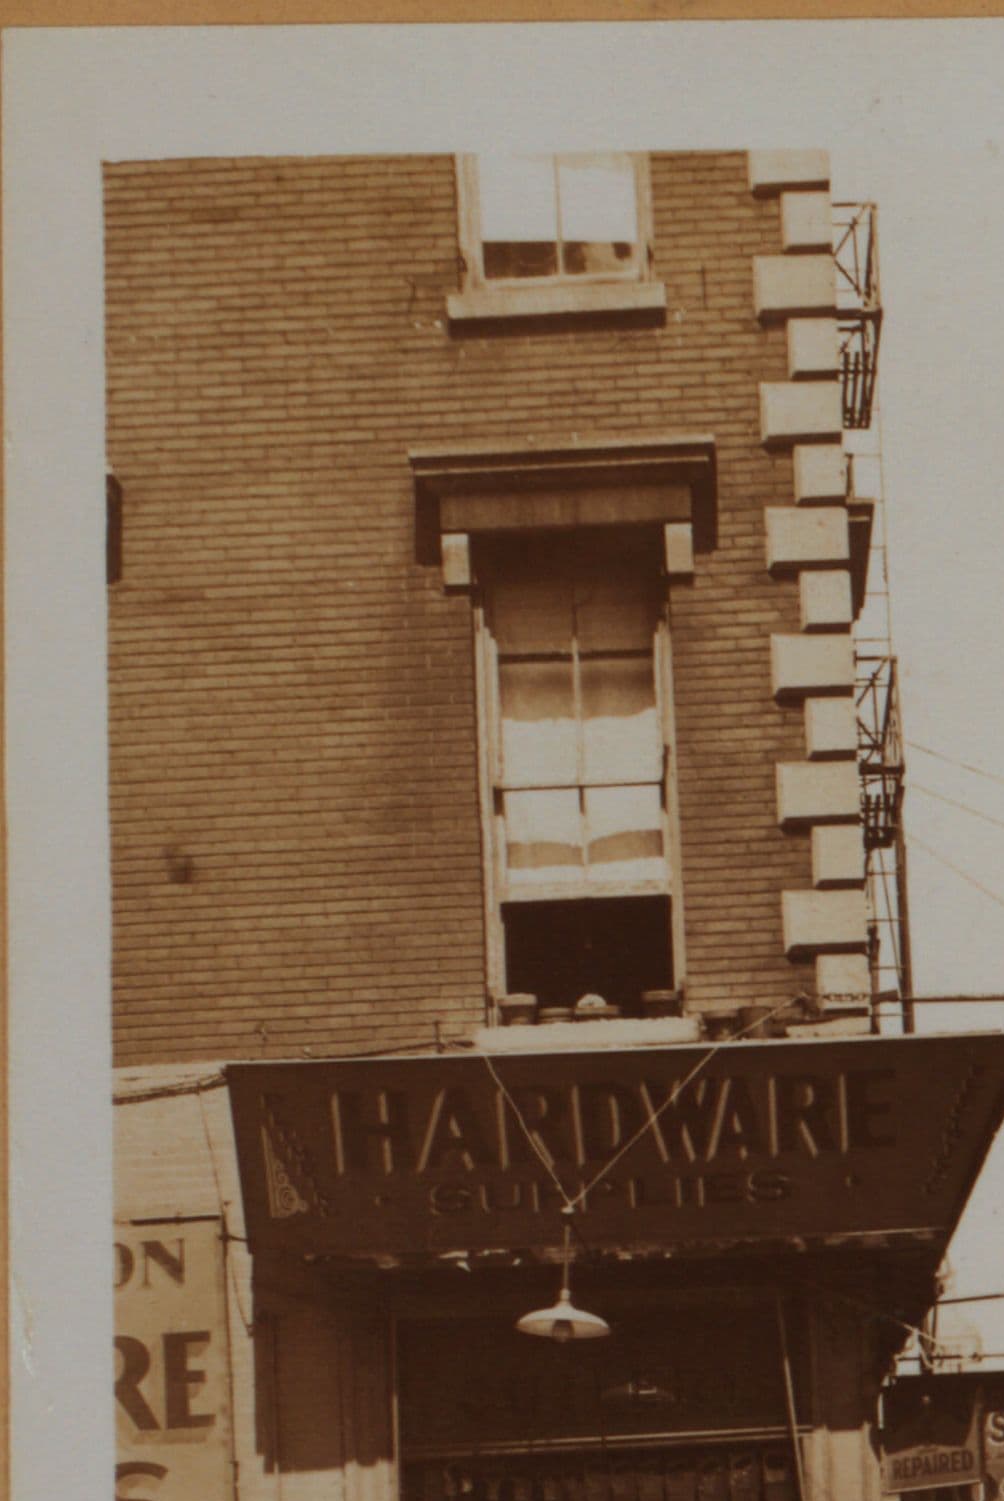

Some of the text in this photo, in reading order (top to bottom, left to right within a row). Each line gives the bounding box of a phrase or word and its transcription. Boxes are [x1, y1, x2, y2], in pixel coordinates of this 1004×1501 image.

[331, 1069, 896, 1177] HARDWARE
[428, 1170, 793, 1216] SUPPLIES
[892, 1449, 975, 1482] REPAIRED
